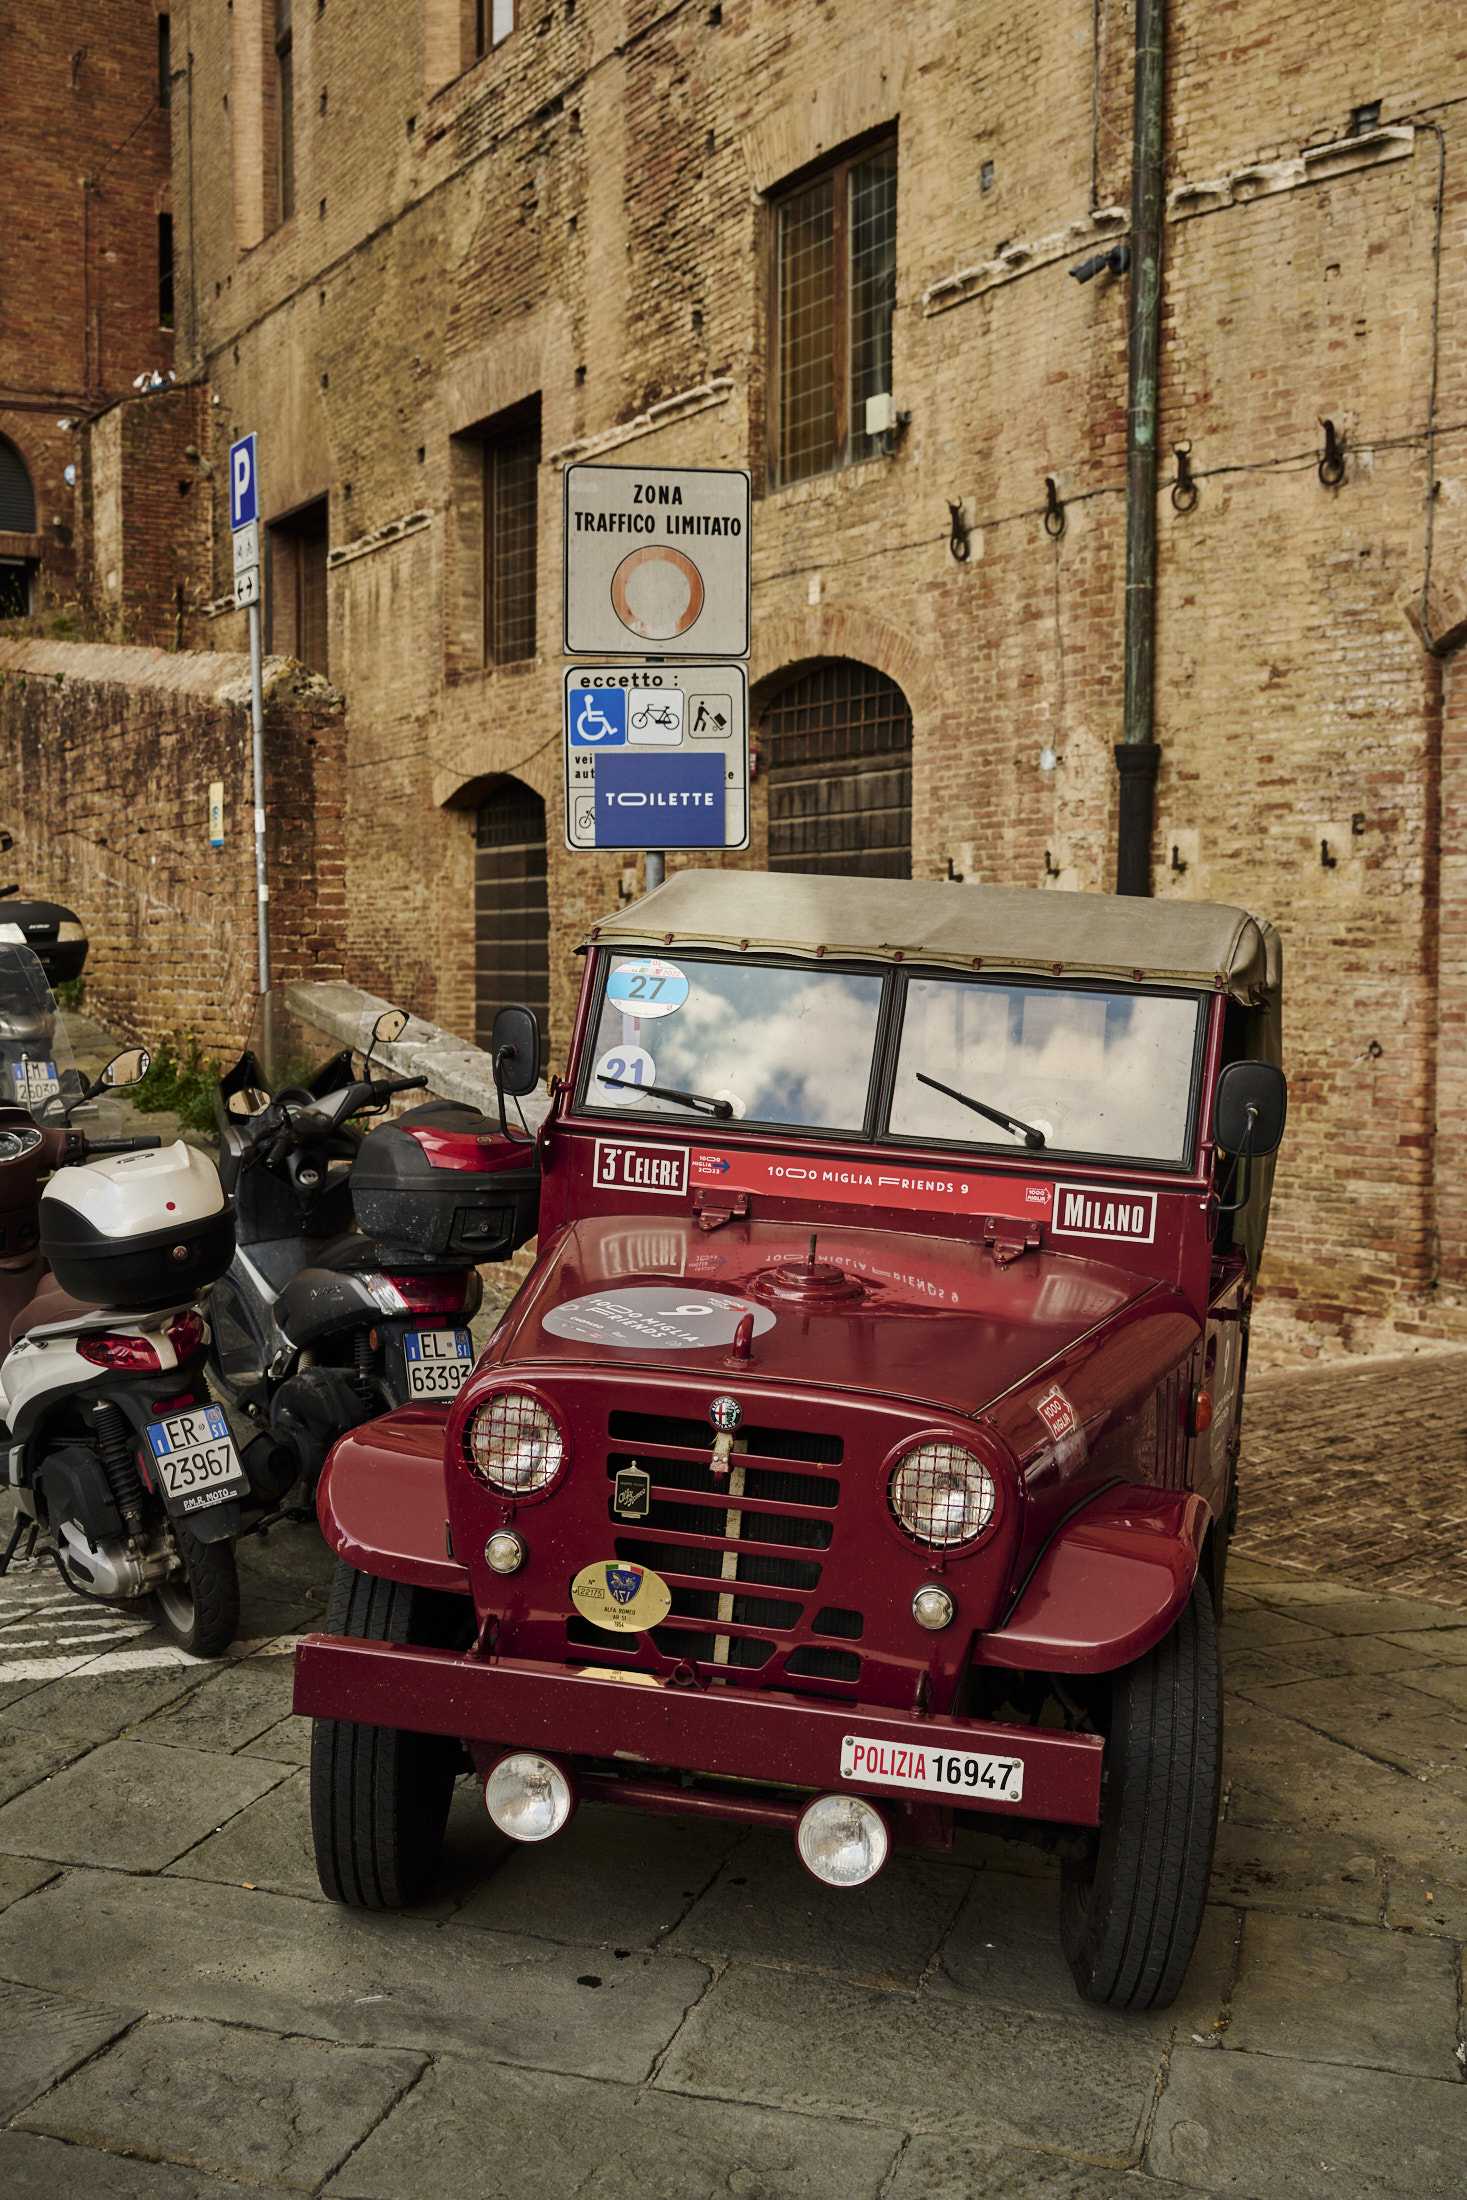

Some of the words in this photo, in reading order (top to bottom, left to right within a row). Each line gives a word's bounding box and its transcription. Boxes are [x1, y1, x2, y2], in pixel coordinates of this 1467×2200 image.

[234, 447, 251, 521] P
[633, 484, 683, 505] ZONA
[574, 511, 656, 534] TRAFFICO
[666, 515, 742, 536] LIMITATO
[580, 672, 664, 688] eccetto
[605, 792, 714, 806] TOILETTE
[628, 975, 667, 1000] 27
[604, 1058, 644, 1090] 21
[692, 1160, 712, 1168] MIGLIA
[767, 1166, 817, 1180] 1000
[822, 1171, 873, 1186] MIGLIA
[878, 1176, 954, 1193] FRIENDS
[960, 1184, 969, 1194] 9
[1063, 1193, 1145, 1233] MILANO
[585, 1306, 667, 1338] FRIENDS
[589, 1299, 643, 1318] 1000
[642, 1317, 700, 1342] MIGLIA
[656, 1304, 714, 1316] 9
[420, 1333, 446, 1358] EL
[1043, 1400, 1062, 1419] 1000
[165, 1417, 200, 1450] ER
[211, 1422, 225, 1438] SI
[1052, 1412, 1071, 1435] MIGLIA
[163, 1444, 231, 1491] 23967
[205, 1488, 229, 1502] MOTO
[580, 1588, 603, 1597] 22175
[853, 1744, 926, 1780] POLIZIA
[932, 1755, 1013, 1791] 16947
